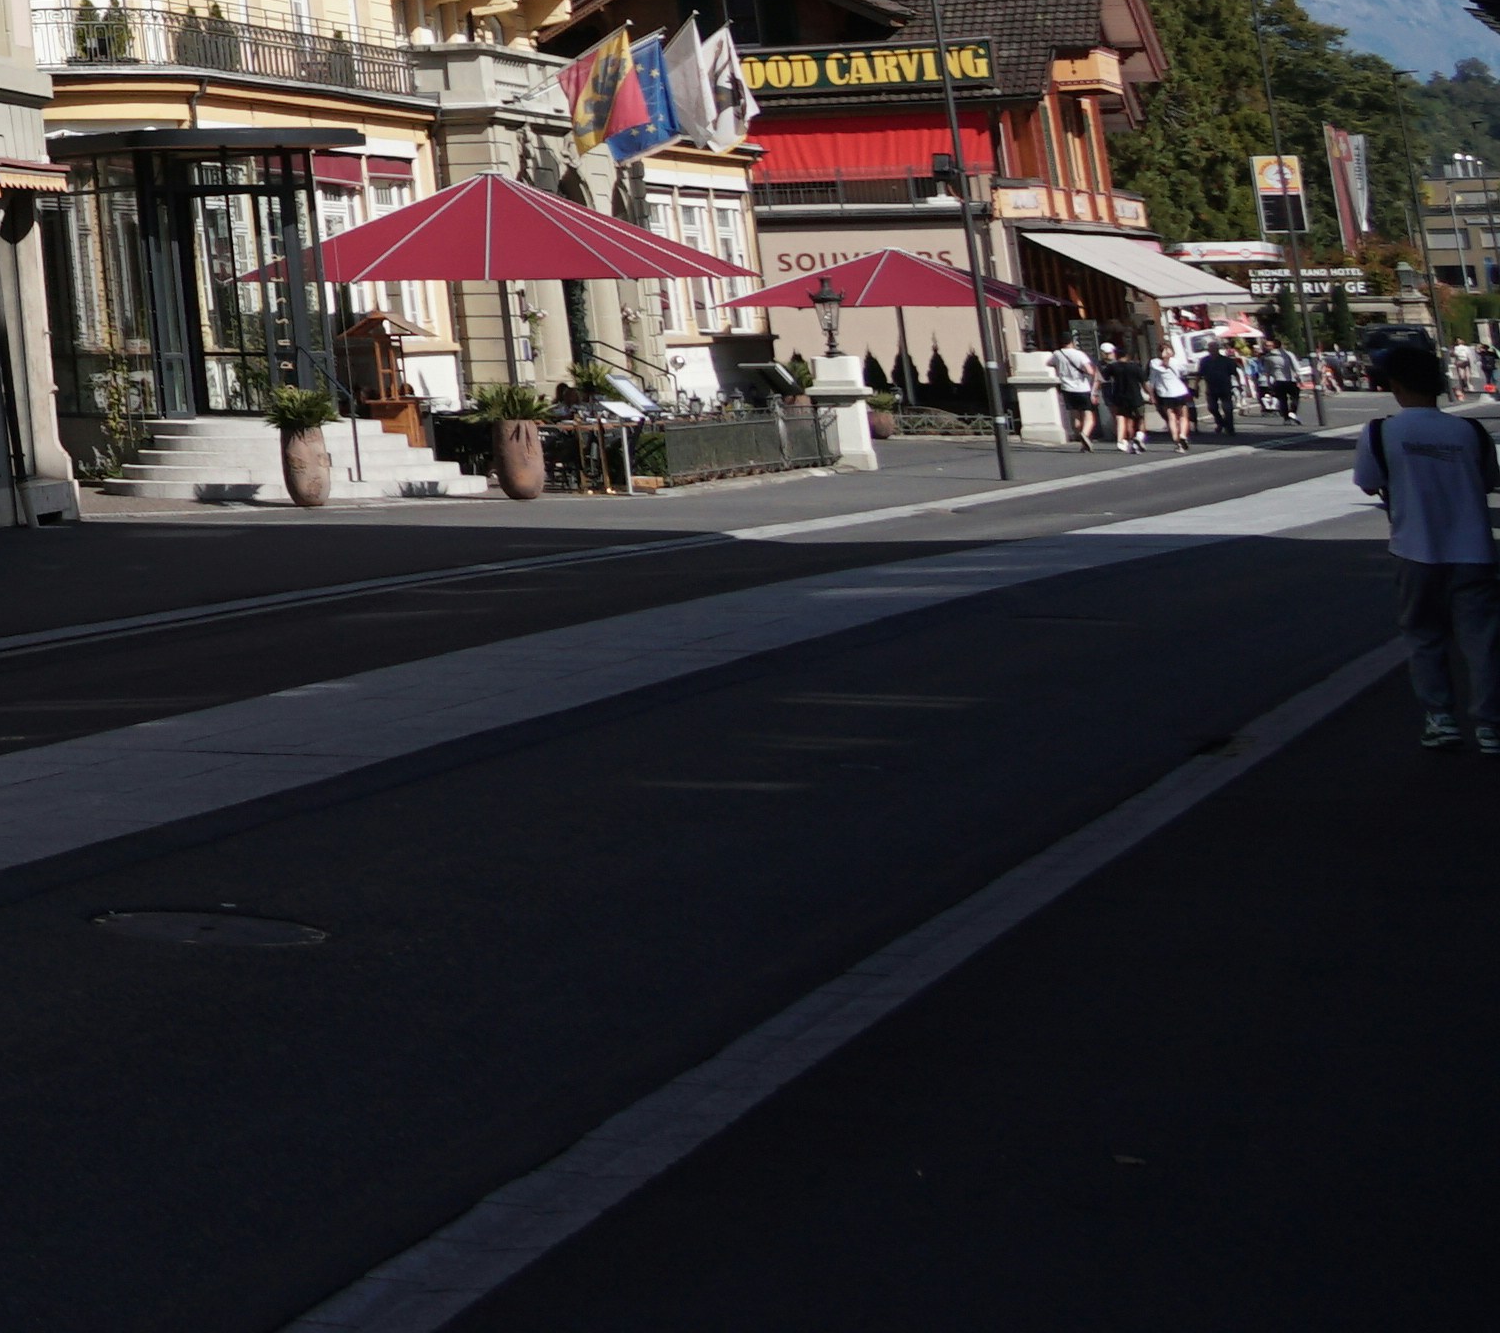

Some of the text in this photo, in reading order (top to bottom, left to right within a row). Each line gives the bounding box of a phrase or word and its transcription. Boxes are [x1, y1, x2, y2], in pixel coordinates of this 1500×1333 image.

[740, 44, 990, 90] OOD CARVING
[1301, 268, 1328, 277] RAND
[1330, 267, 1363, 276] HOTEL
[1302, 281, 1367, 293] RIVGE
